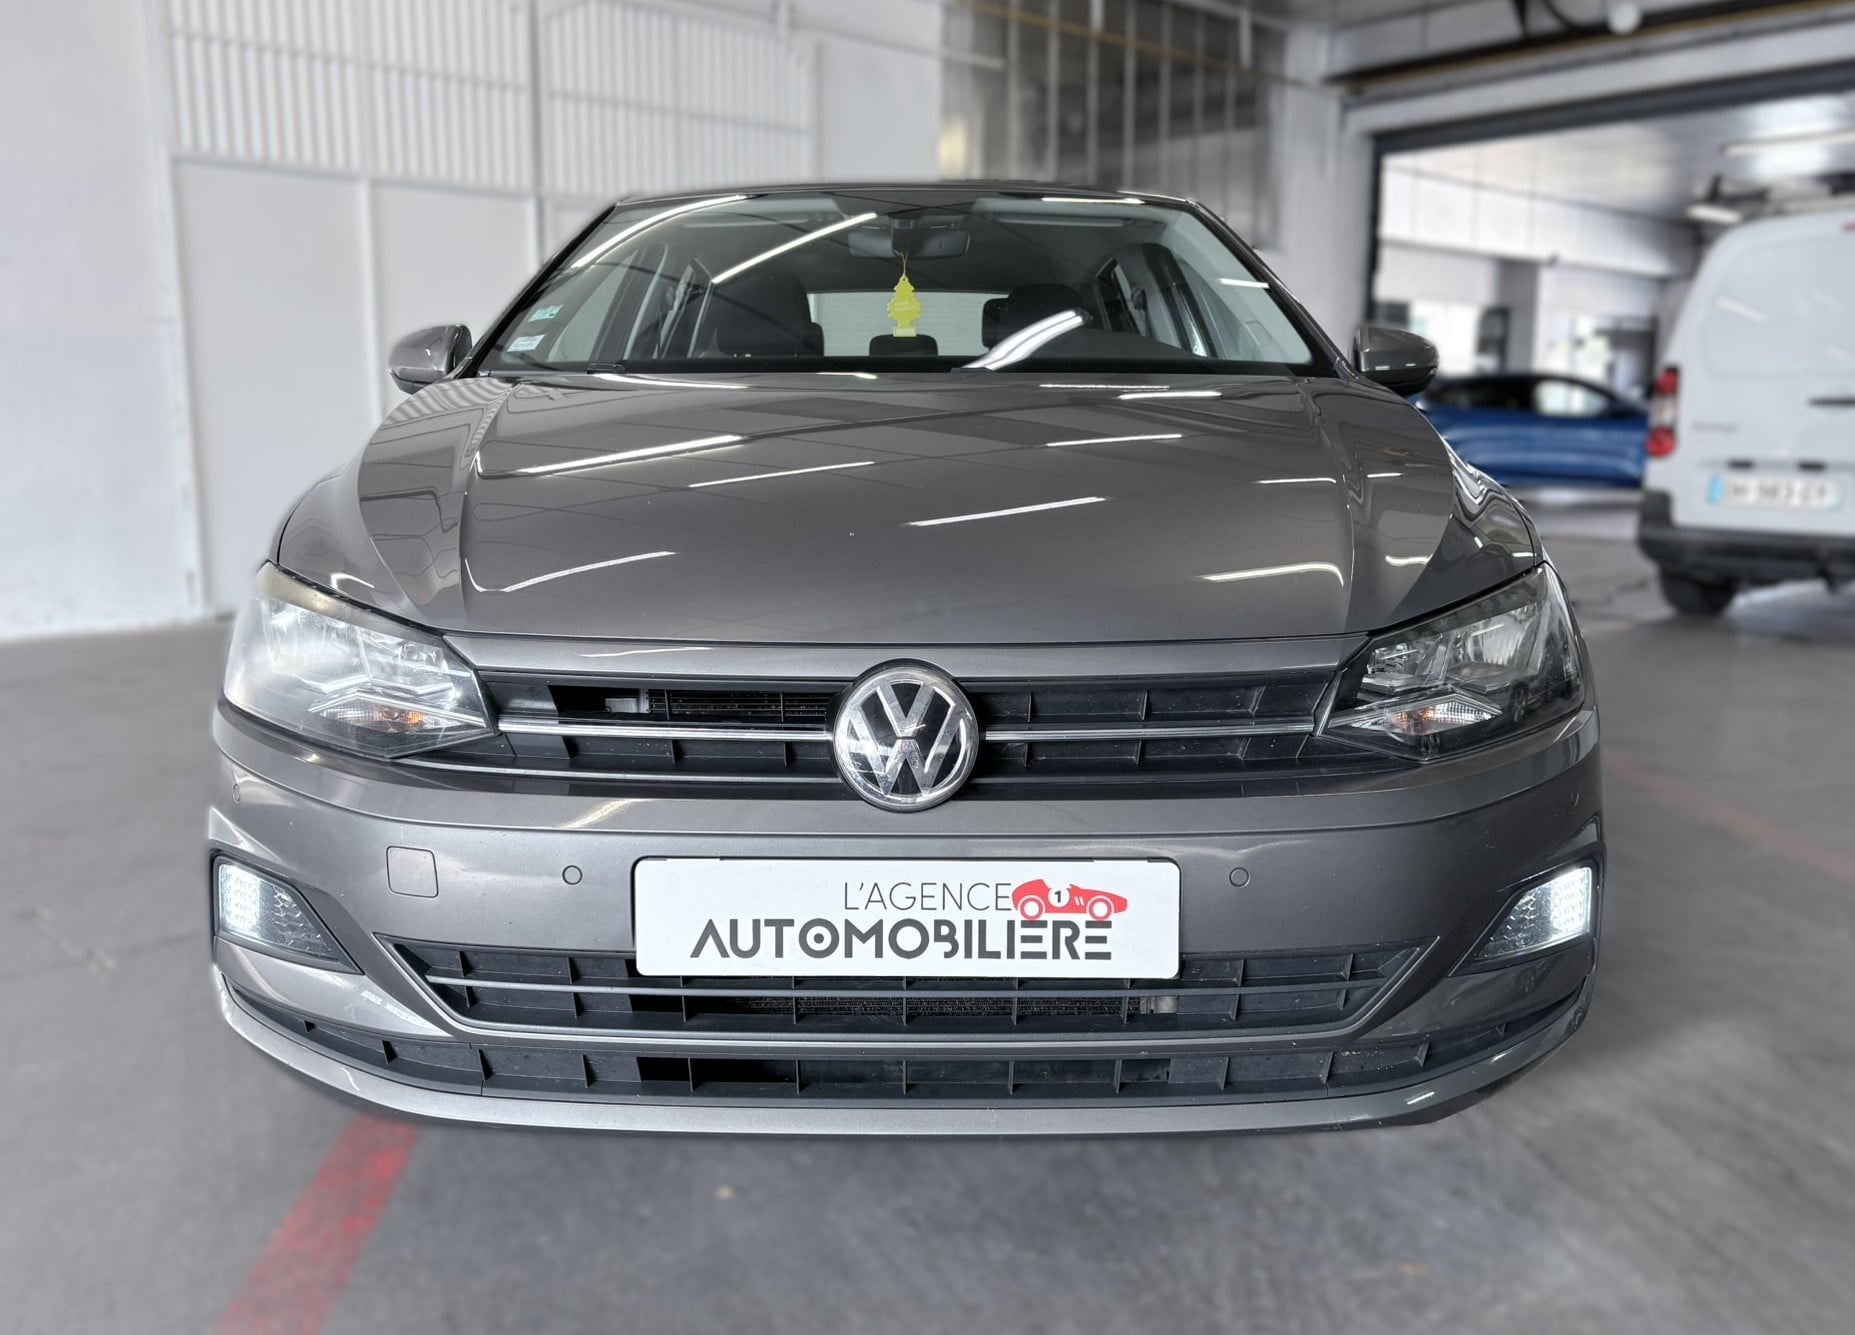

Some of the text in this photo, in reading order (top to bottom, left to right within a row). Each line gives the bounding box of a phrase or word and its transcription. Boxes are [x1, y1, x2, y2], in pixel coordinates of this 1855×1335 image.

[844, 881, 1013, 911] L'AGENCE
[1053, 889, 1063, 904] 1
[689, 917, 1113, 961] AUTOMOBILIERE
